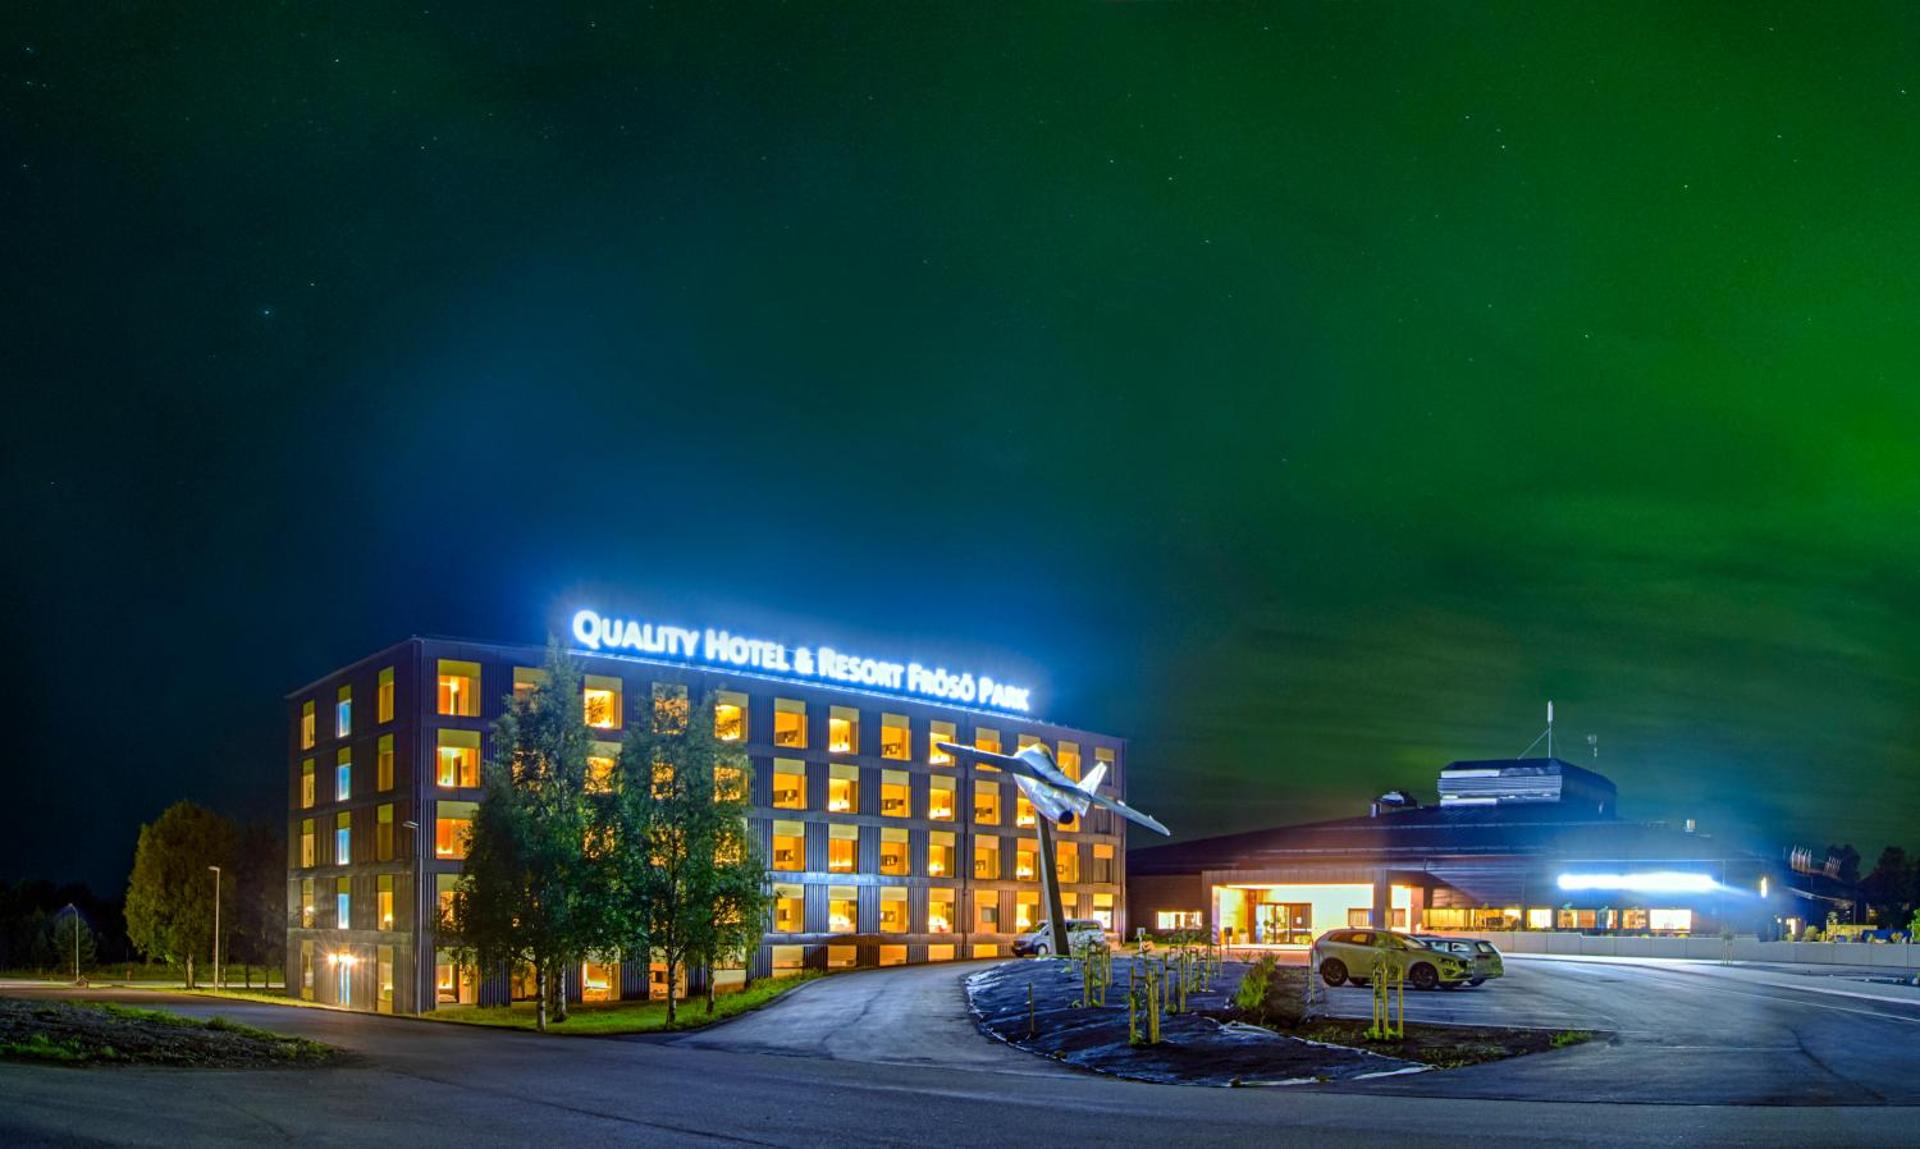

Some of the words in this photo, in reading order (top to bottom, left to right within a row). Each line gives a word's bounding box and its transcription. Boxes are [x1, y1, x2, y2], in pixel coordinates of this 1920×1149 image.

[573, 610, 699, 656] QUALITY
[706, 629, 789, 670] HOTEL
[794, 647, 813, 674] &
[818, 647, 904, 688] RESORT
[979, 677, 1030, 711] PARK
